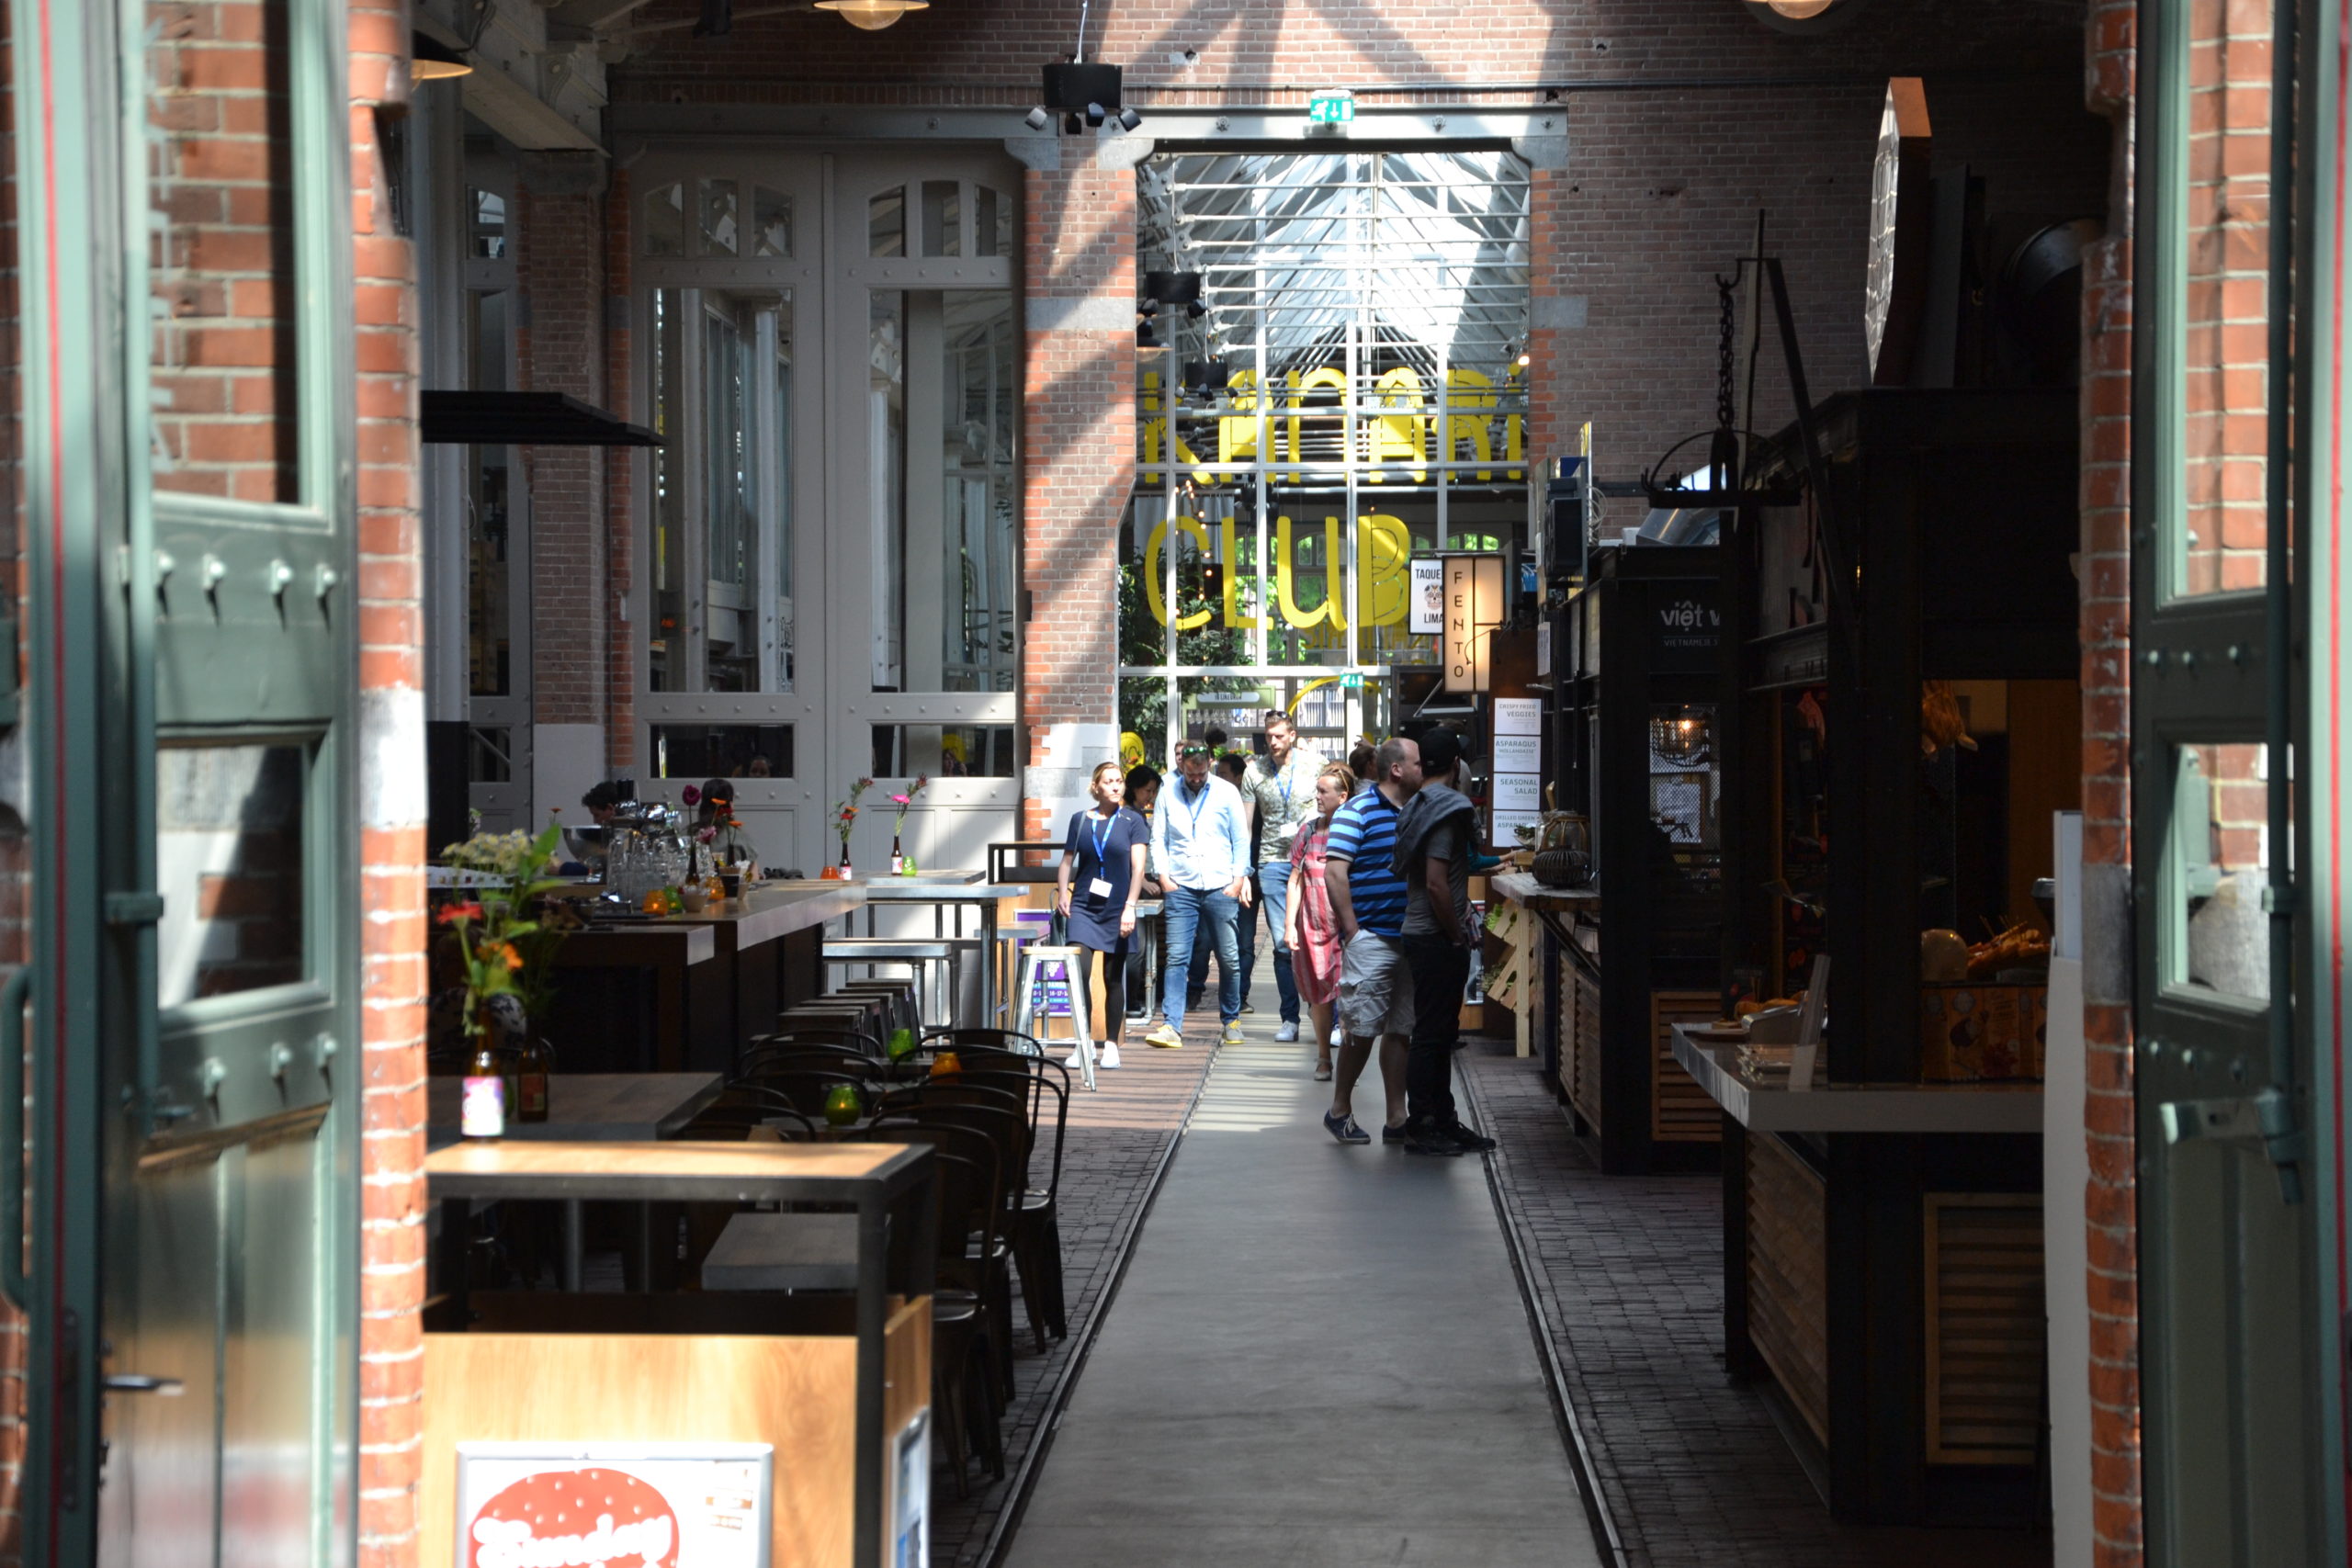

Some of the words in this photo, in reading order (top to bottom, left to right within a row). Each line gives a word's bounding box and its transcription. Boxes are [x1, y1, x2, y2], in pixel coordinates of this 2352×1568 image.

[1415, 569, 1442, 580] TAQUE
[1424, 613, 1442, 624] LIMA
[1453, 571, 1464, 678] FENTO
